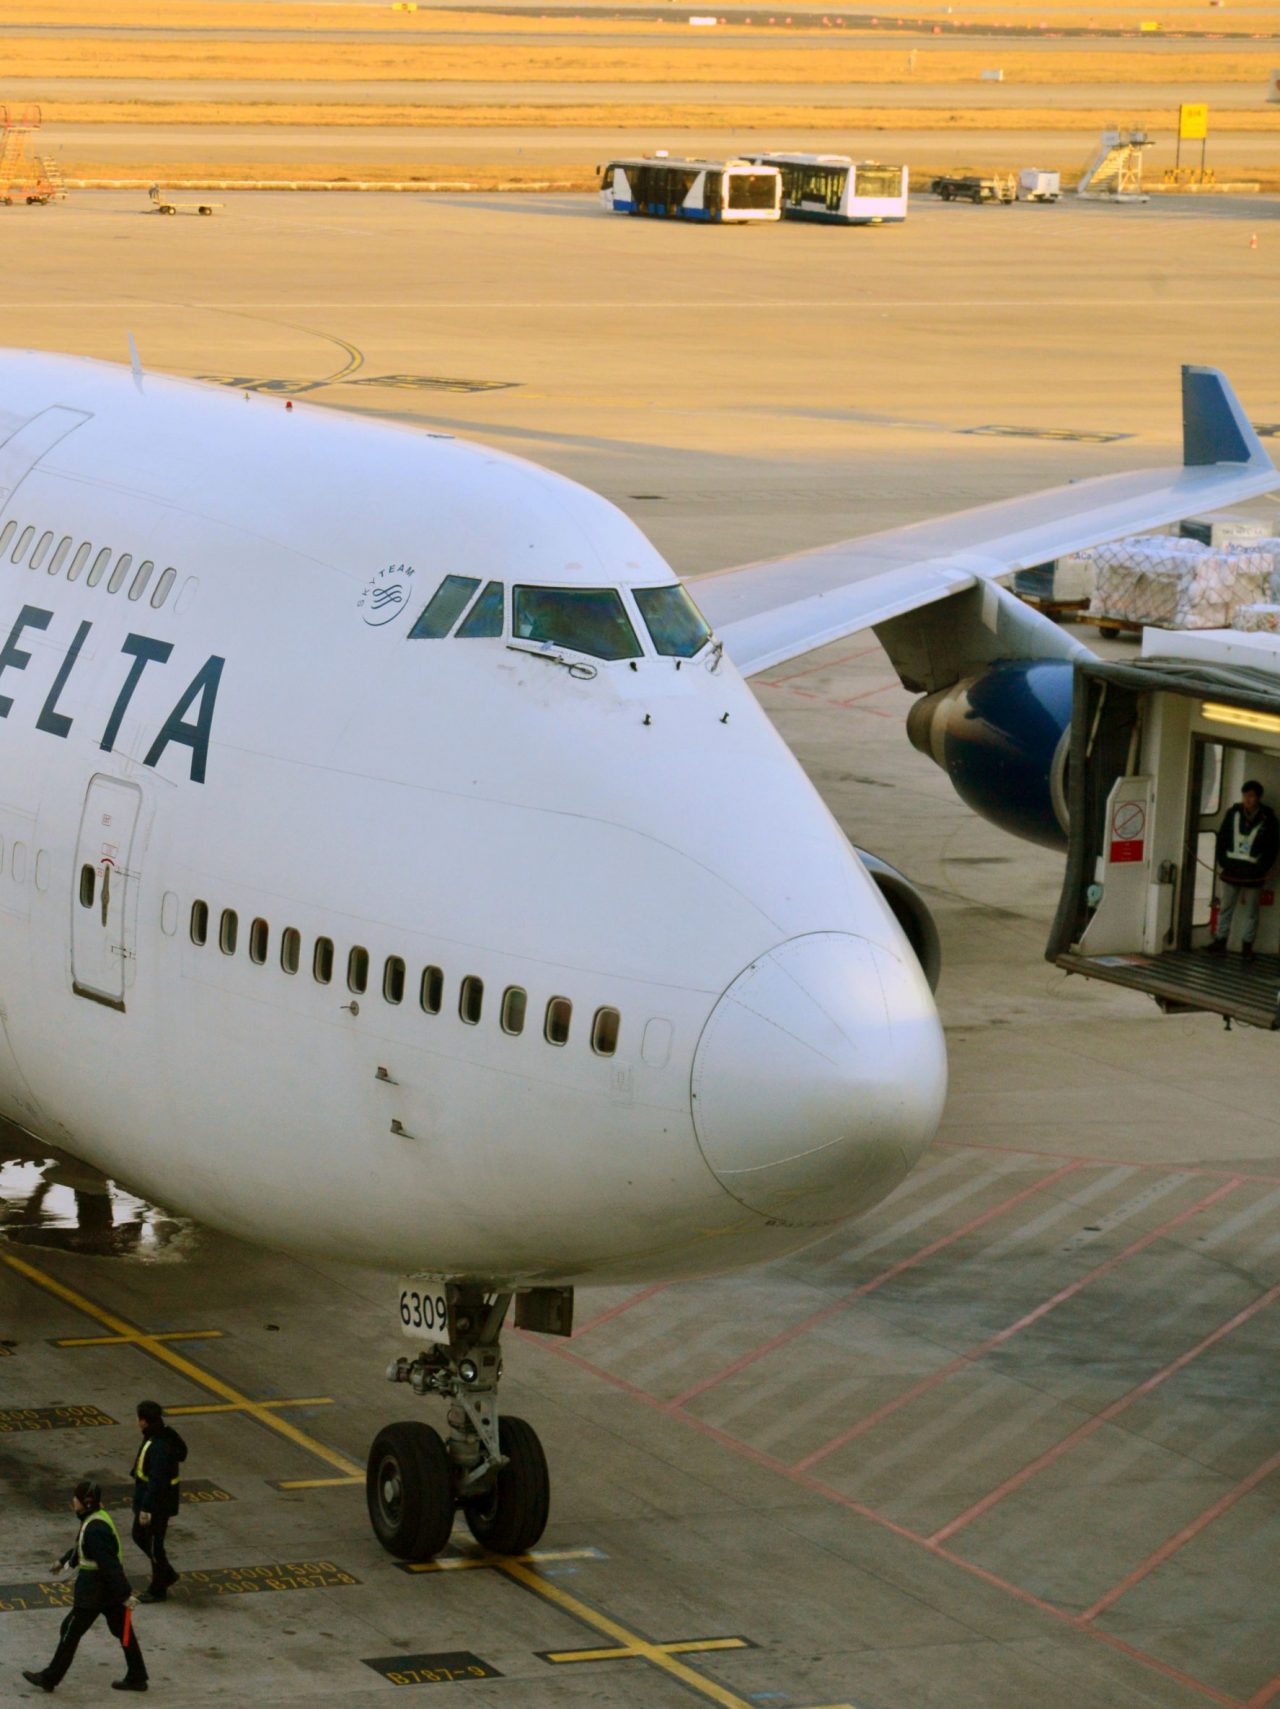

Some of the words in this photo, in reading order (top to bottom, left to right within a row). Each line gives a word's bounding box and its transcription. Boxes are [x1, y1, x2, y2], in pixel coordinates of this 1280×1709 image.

[400, 1290, 448, 1332] 6309
[264, 1573, 357, 1591] B787-8
[386, 1665, 487, 1686] B787-9
